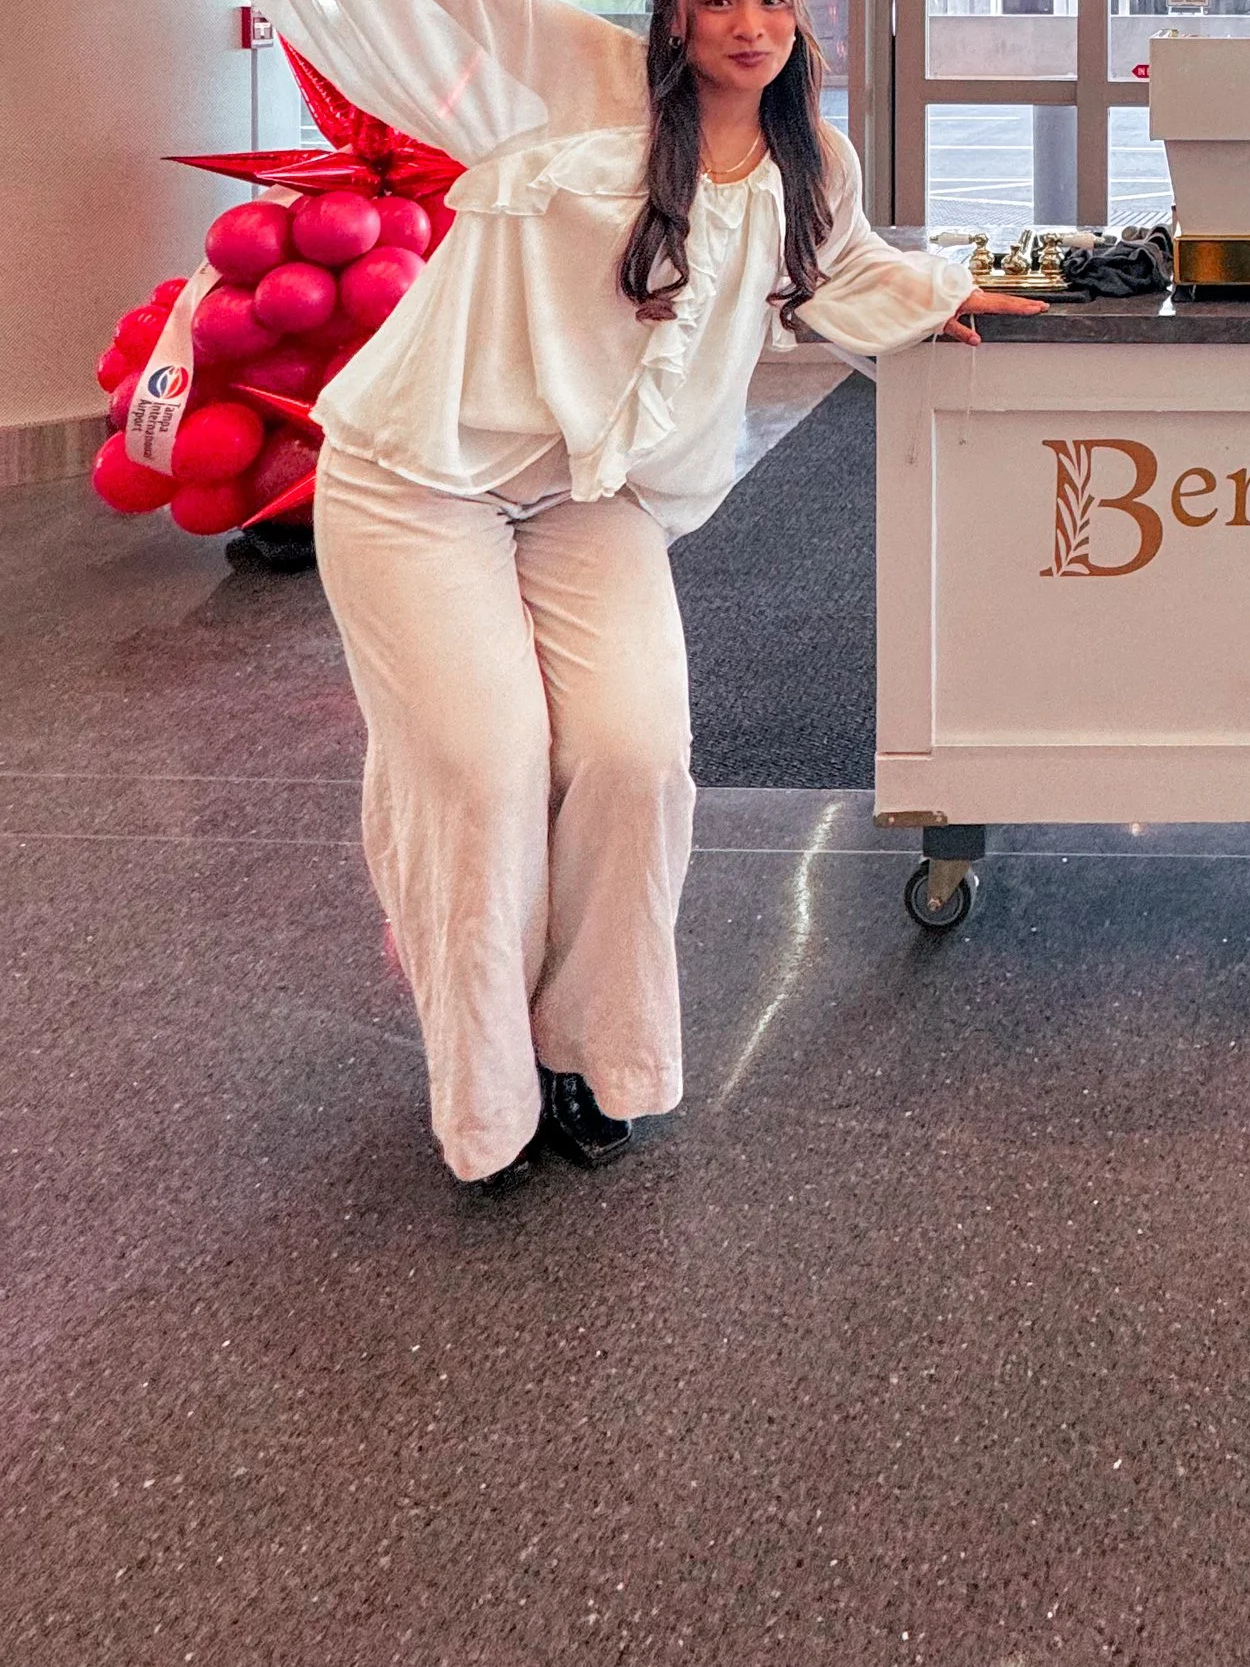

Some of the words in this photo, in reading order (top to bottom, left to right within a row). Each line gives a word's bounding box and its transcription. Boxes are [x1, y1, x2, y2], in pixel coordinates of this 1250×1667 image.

[1137, 67, 1146, 76] IN
[131, 398, 153, 432] Airport
[157, 402, 181, 432] Tampa
